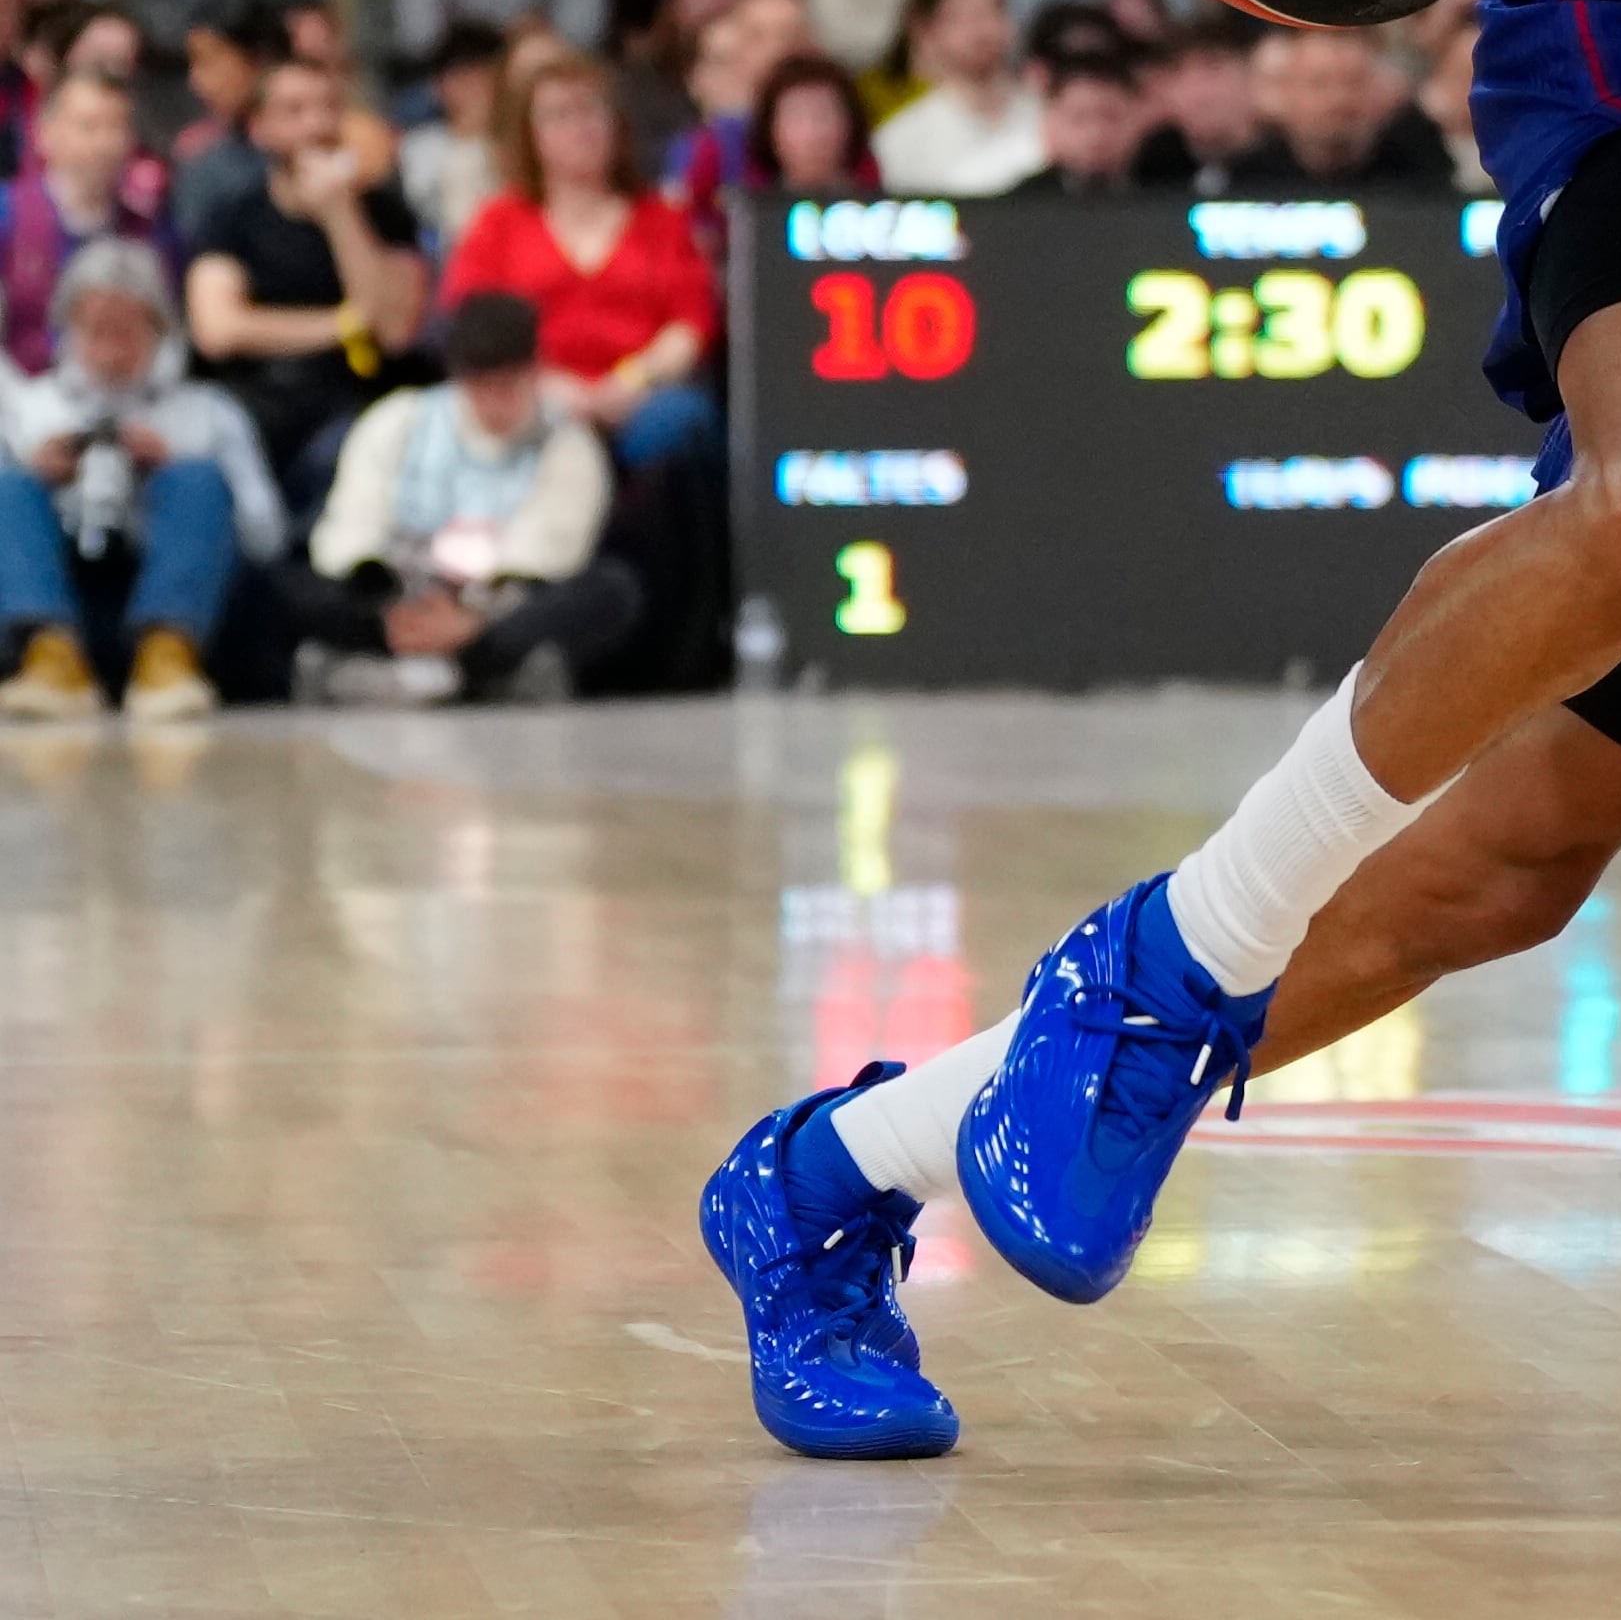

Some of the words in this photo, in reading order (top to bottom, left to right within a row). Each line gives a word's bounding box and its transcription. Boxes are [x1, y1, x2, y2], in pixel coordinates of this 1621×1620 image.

[811, 271, 977, 381] 10
[1126, 267, 1426, 380] 2:30
[835, 539, 907, 636] 1
